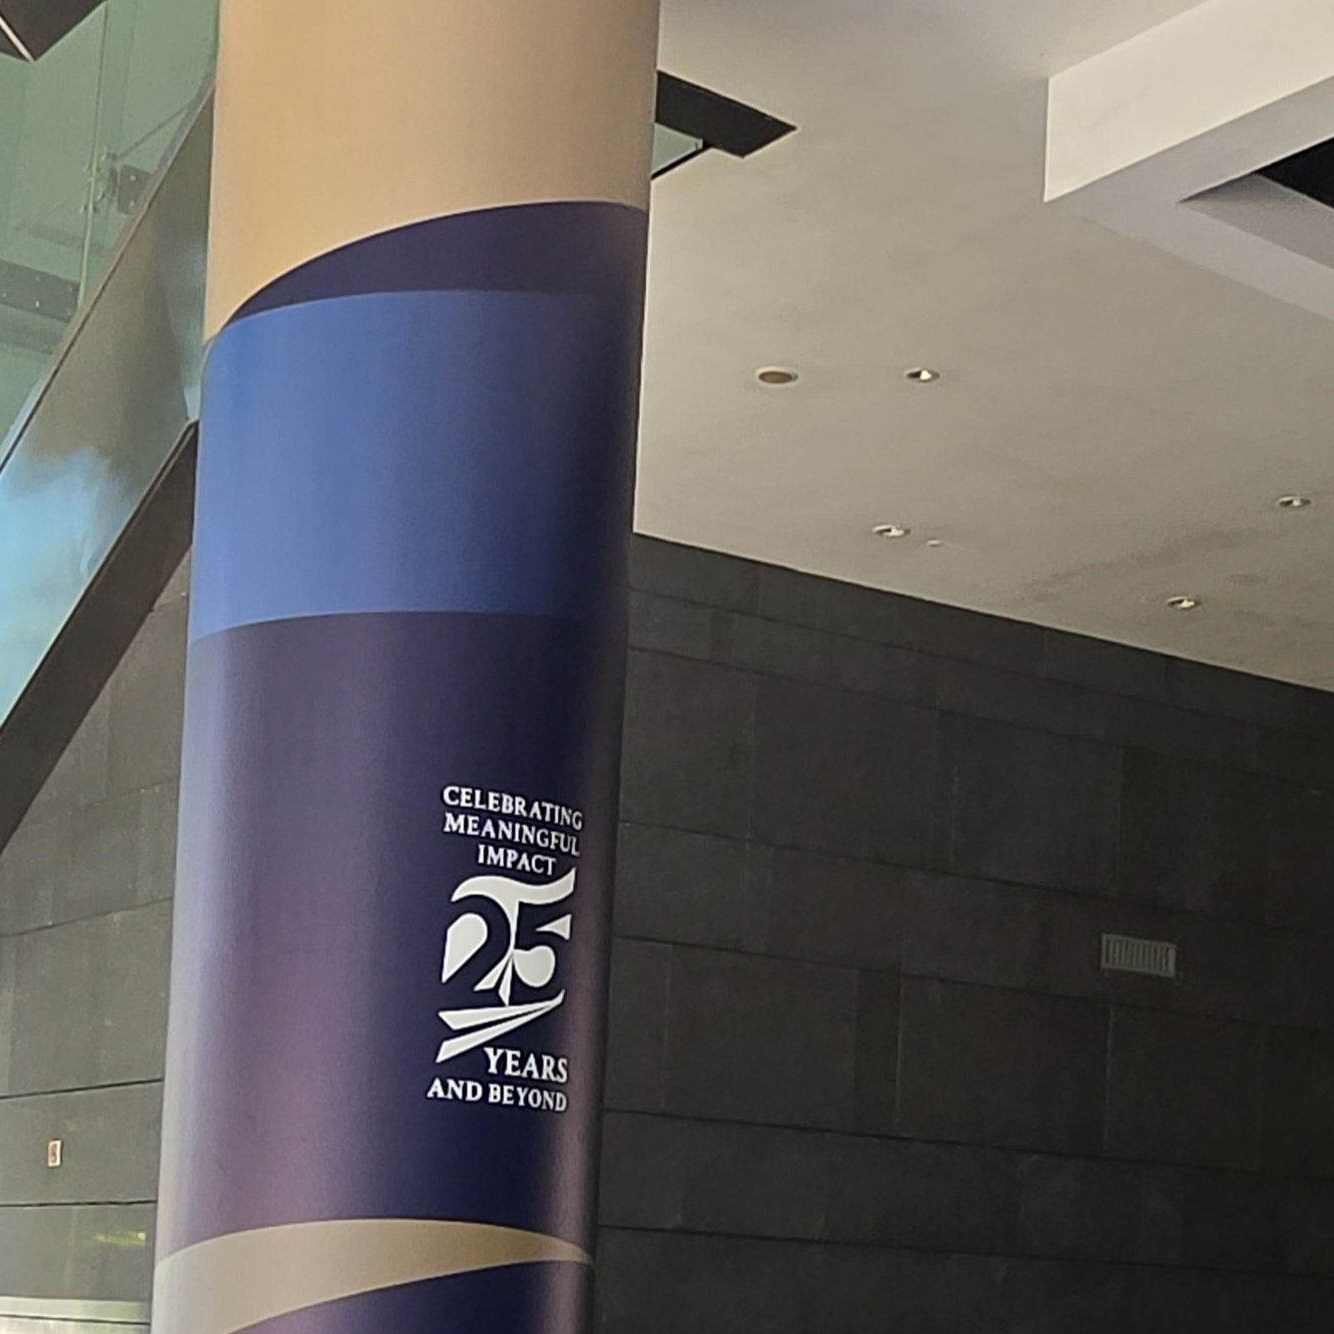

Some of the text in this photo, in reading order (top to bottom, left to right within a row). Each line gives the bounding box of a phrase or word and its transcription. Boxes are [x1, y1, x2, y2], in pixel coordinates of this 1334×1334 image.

[443, 786, 582, 830] CELEBRATING
[443, 812, 580, 856] MEANINGFUL
[477, 844, 557, 875] IMPACT
[484, 1047, 568, 1083] YEARS
[427, 1077, 567, 1112] AND BEYOND
